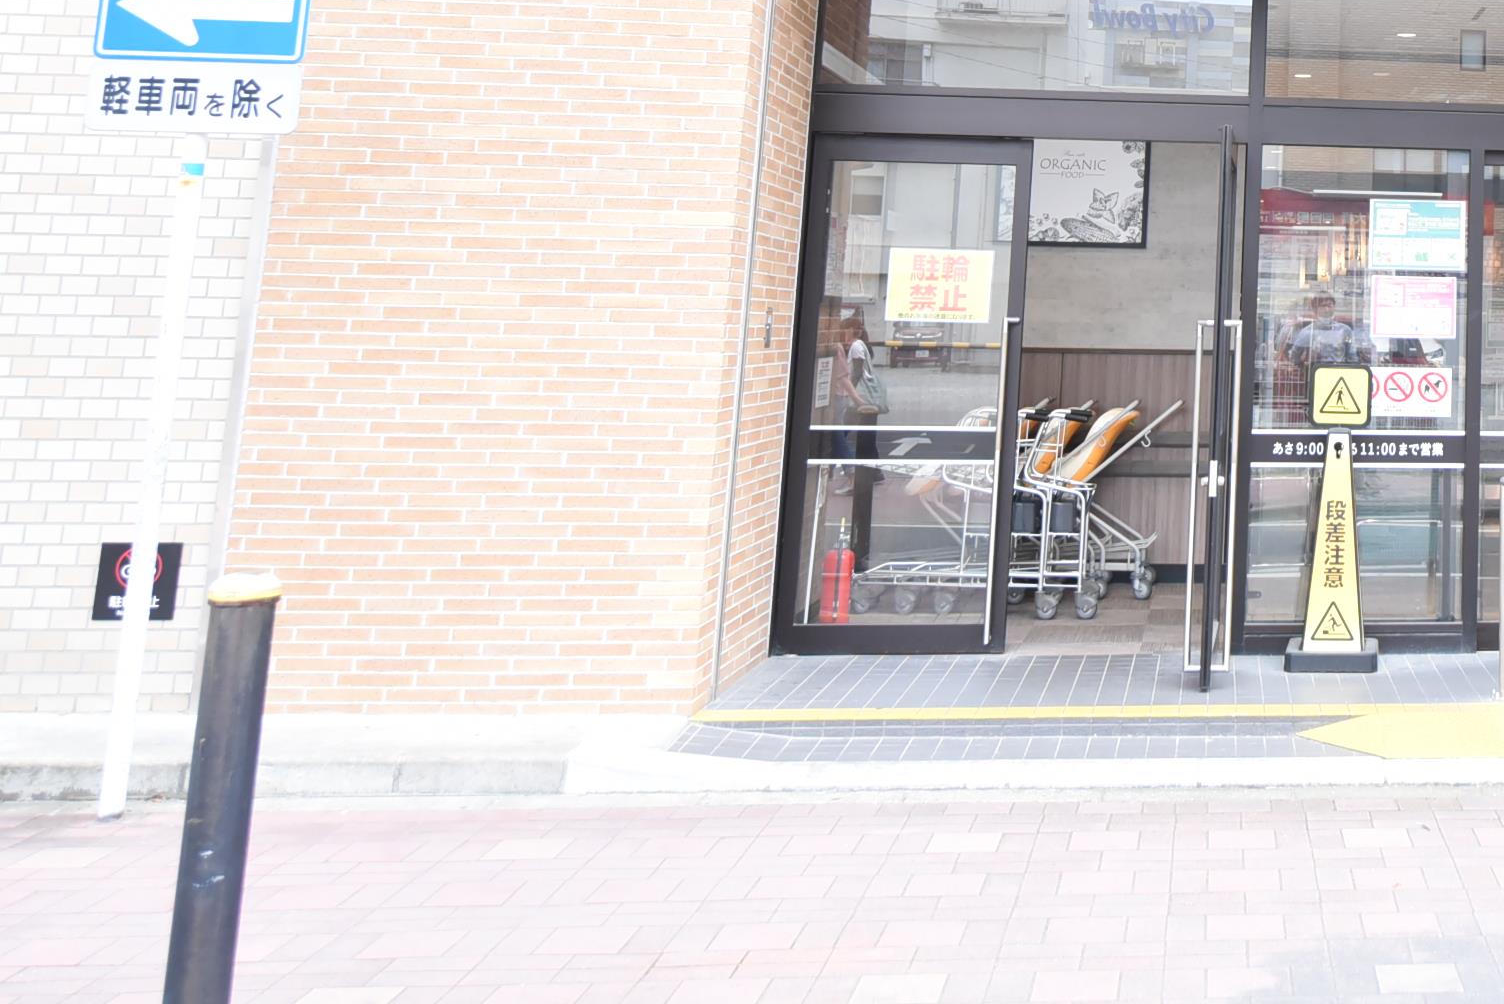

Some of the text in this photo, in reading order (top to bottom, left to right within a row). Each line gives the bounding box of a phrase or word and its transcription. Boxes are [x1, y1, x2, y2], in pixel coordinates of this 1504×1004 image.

[99, 74, 284, 119] 軽車両を除く
[1039, 157, 1106, 171] ORGANIC
[1060, 171, 1084, 179] FOOD
[910, 254, 970, 283] 駐輪
[909, 285, 967, 312] 禁止
[1323, 499, 1347, 588] 段差注意
